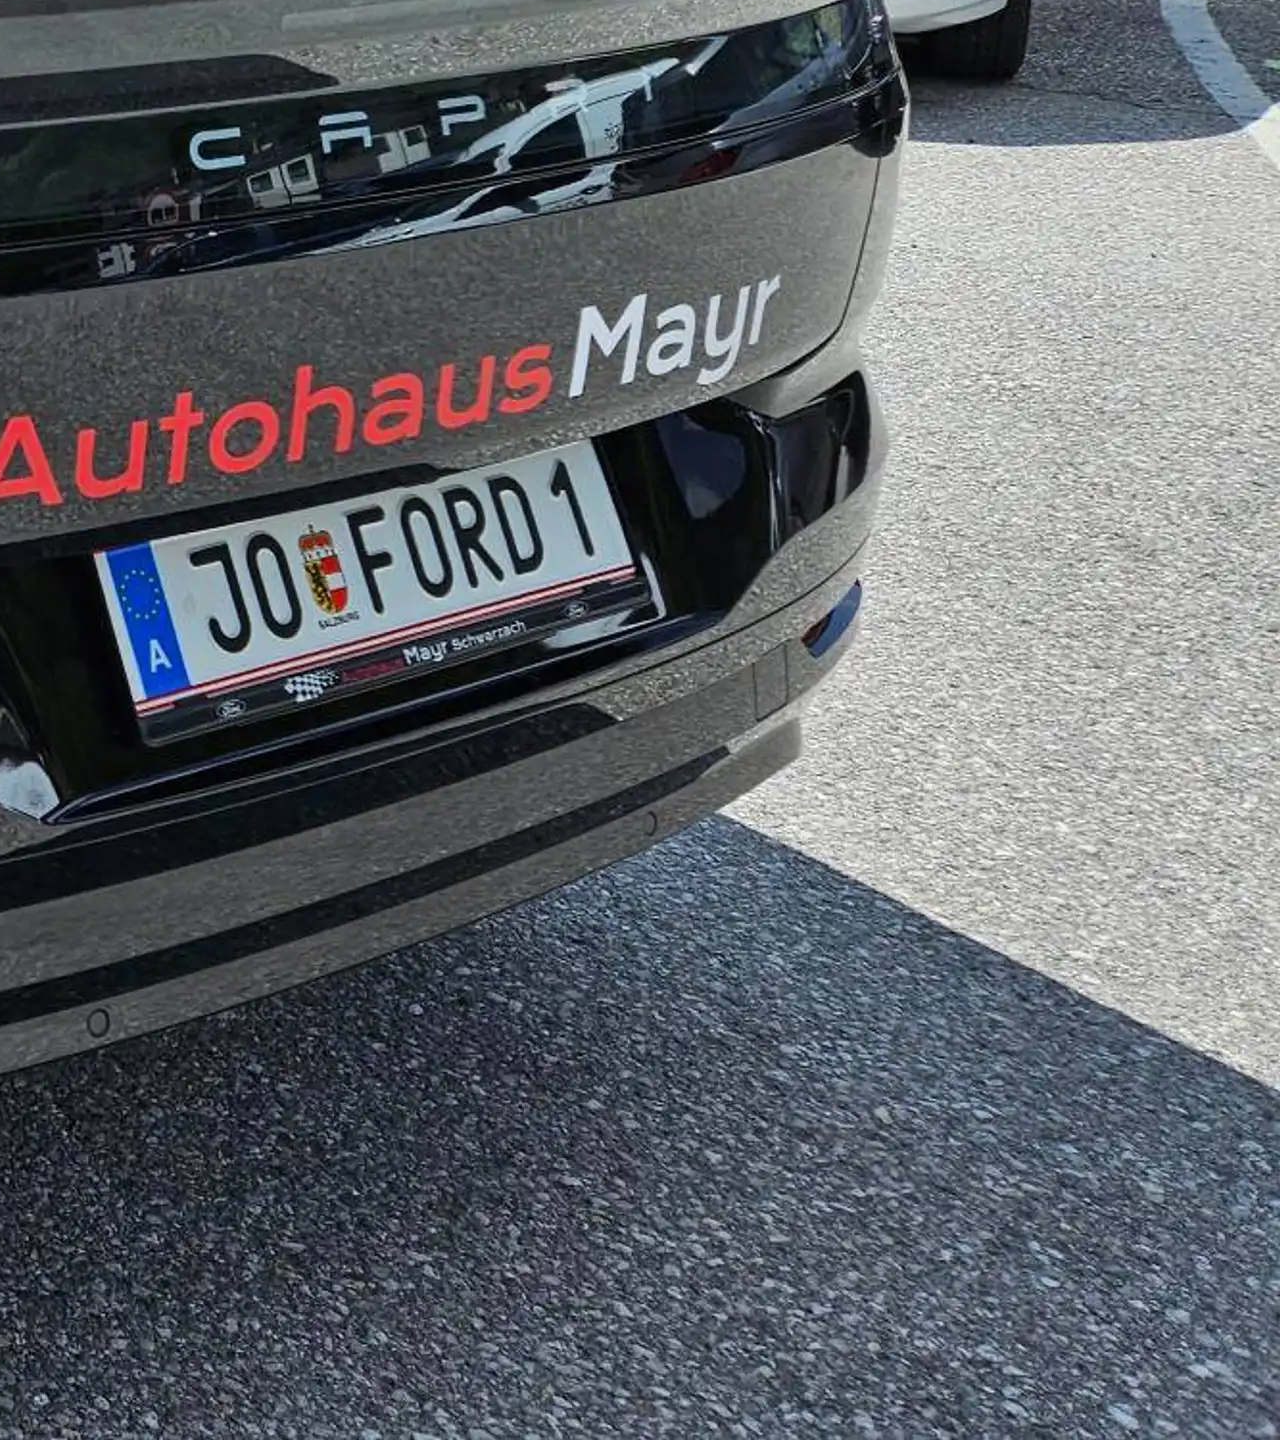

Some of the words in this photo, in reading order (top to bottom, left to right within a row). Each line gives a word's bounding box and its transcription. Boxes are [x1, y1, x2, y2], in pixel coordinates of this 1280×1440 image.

[567, 274, 781, 398] Mayr
[189, 532, 303, 653] JO
[344, 475, 544, 615] FORD
[549, 459, 594, 558] 1
[148, 638, 173, 673] A
[402, 640, 449, 664] Mayr
[451, 620, 526, 651] Schwarzach
